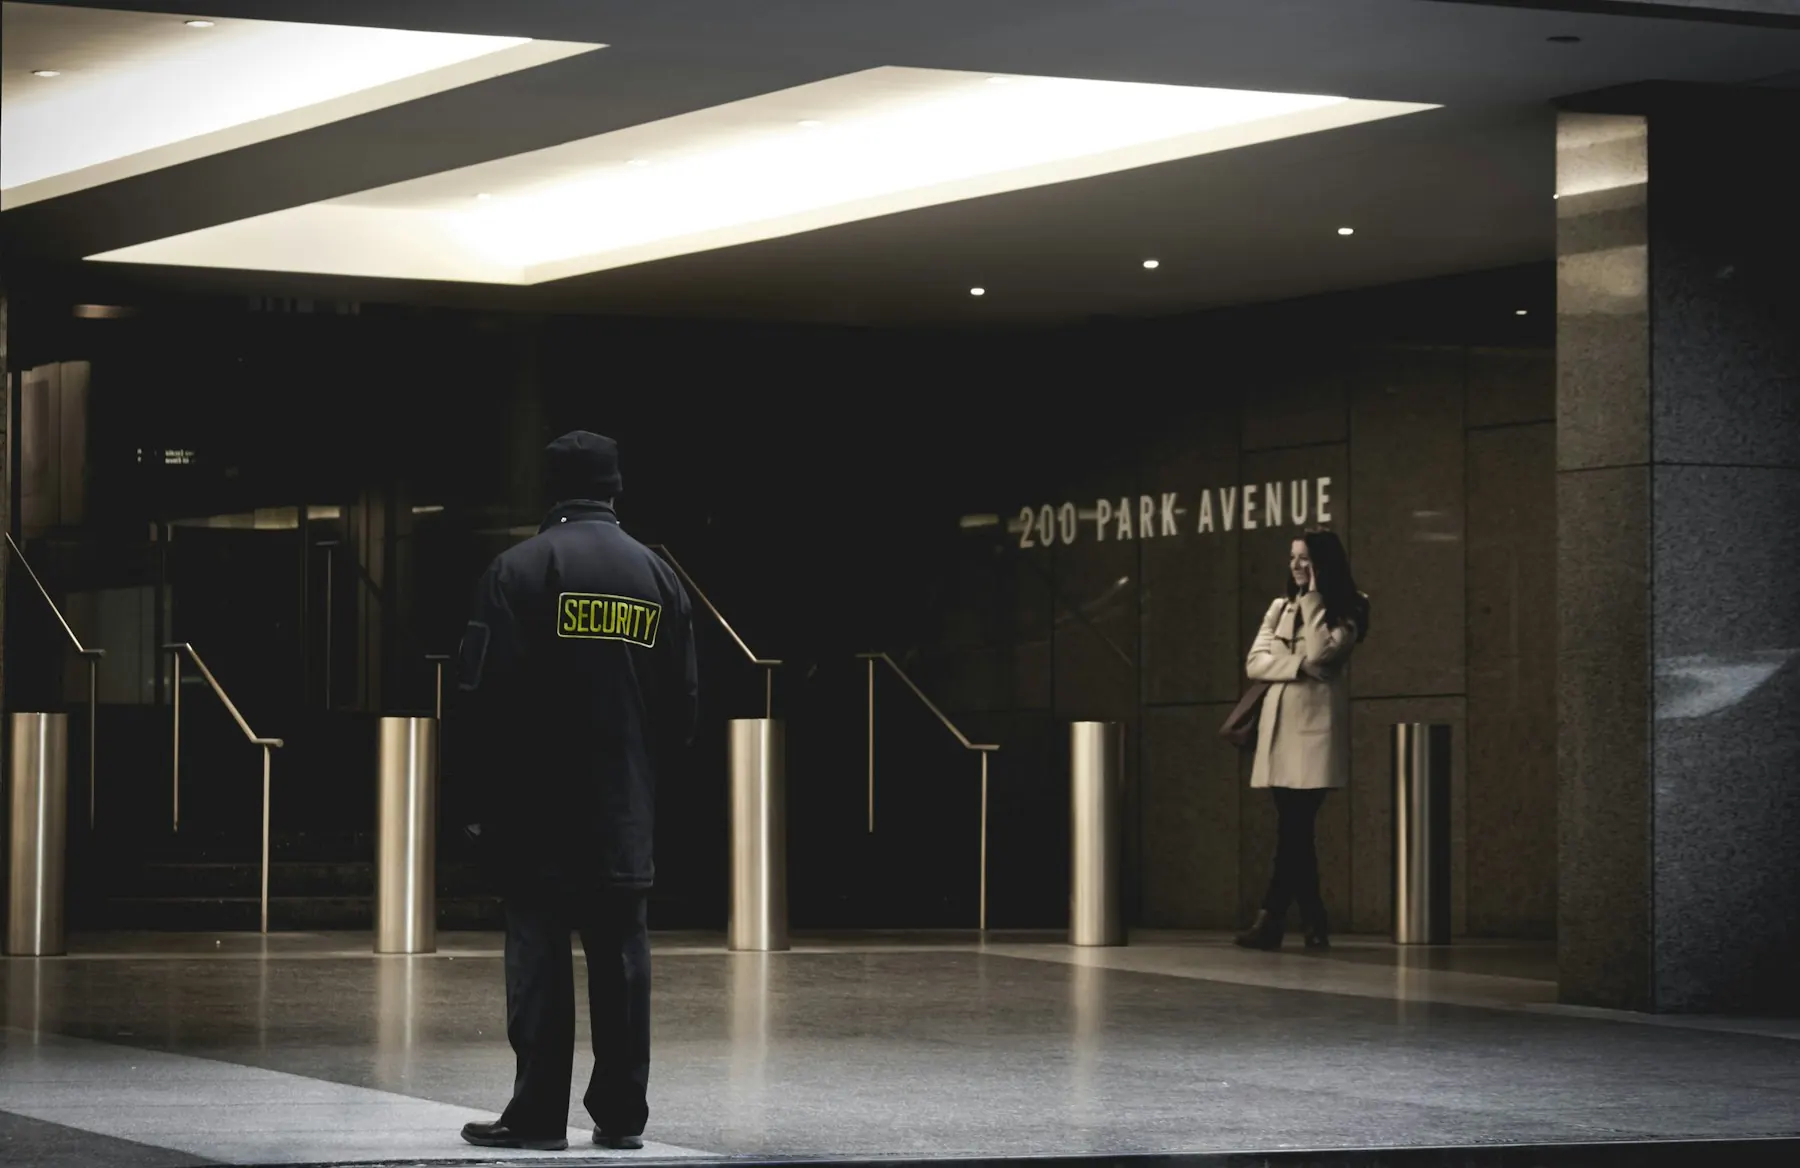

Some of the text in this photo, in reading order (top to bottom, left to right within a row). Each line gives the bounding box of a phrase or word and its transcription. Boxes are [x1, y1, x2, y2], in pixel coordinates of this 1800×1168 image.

[1019, 476, 1332, 548] 200 PARK AVENUE
[563, 598, 657, 641] SECURITY
